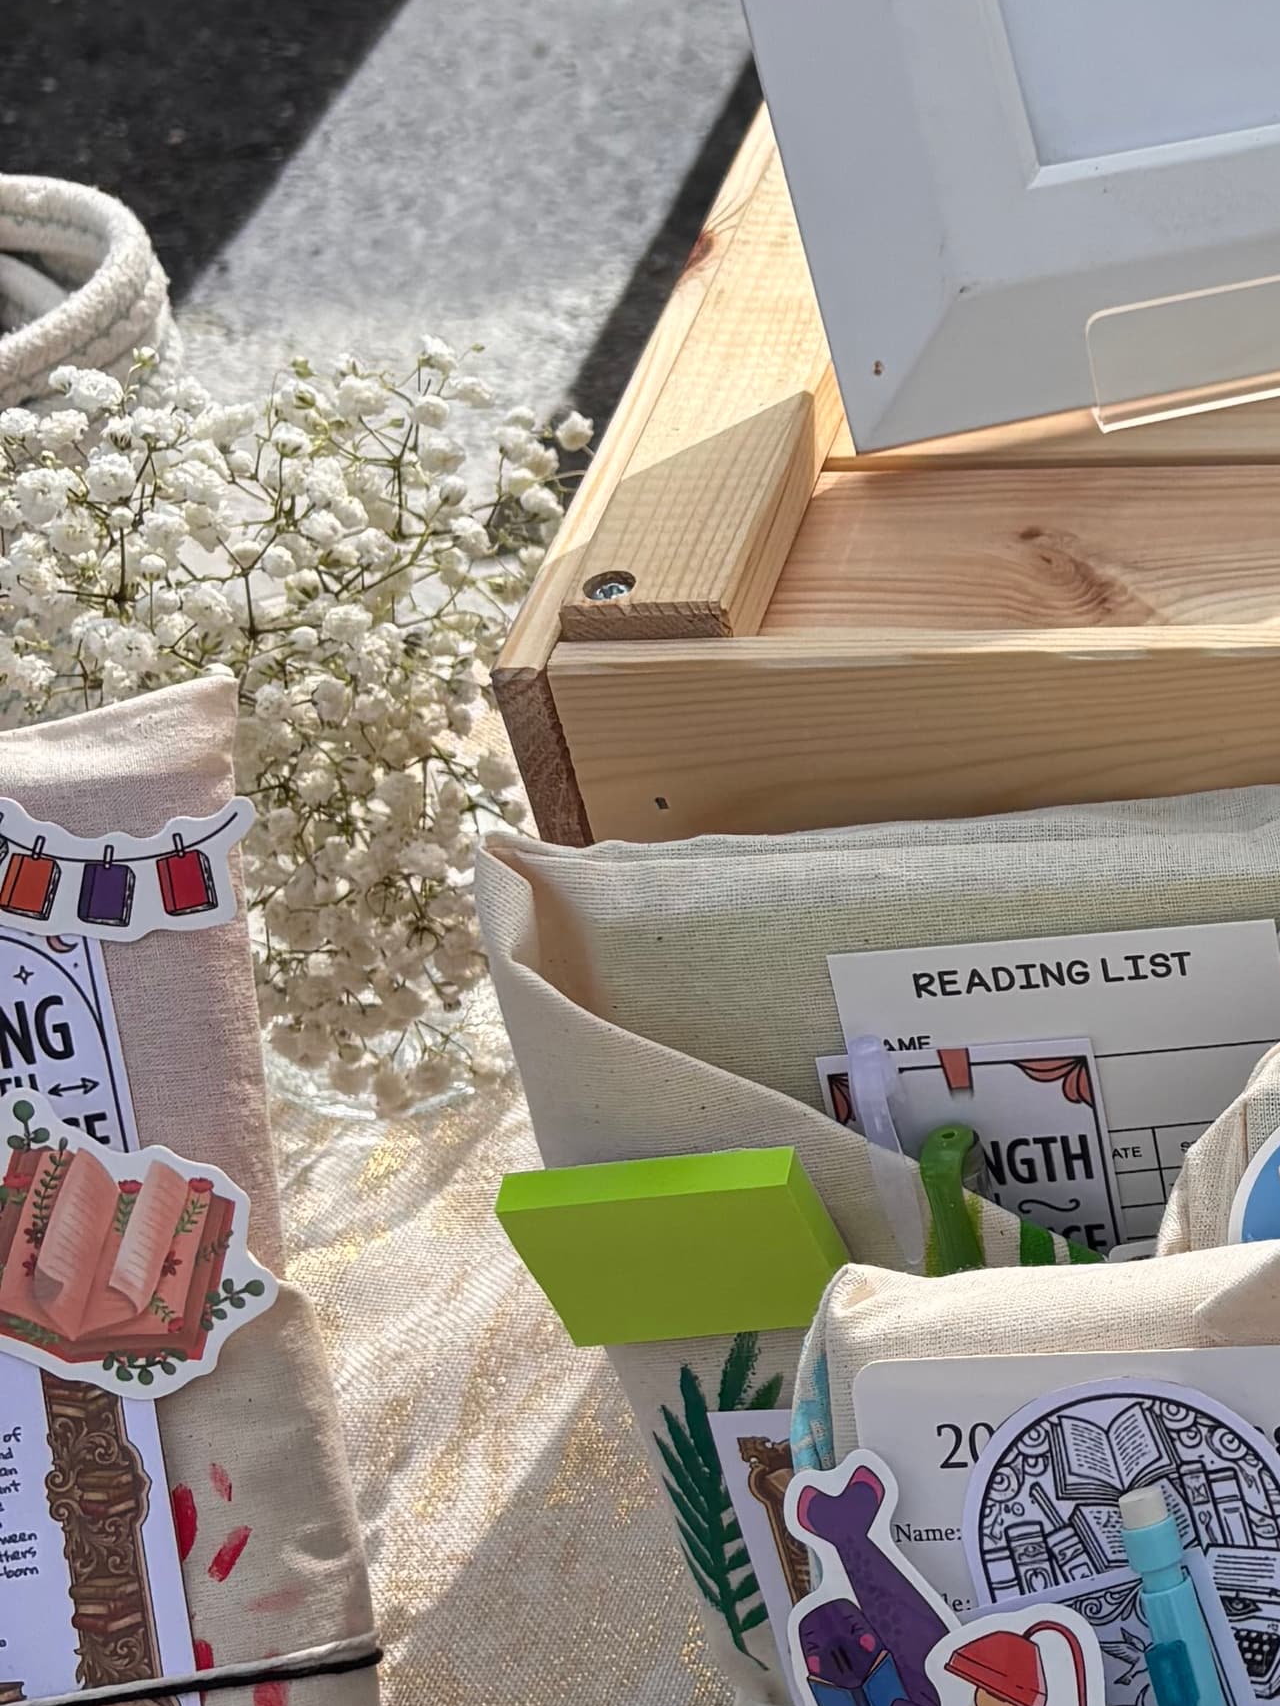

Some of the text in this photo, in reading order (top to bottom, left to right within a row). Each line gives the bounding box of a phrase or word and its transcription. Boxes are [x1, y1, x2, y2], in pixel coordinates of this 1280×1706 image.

[912, 950, 1192, 999] READING LIST
[895, 1523, 962, 1543] Name:
